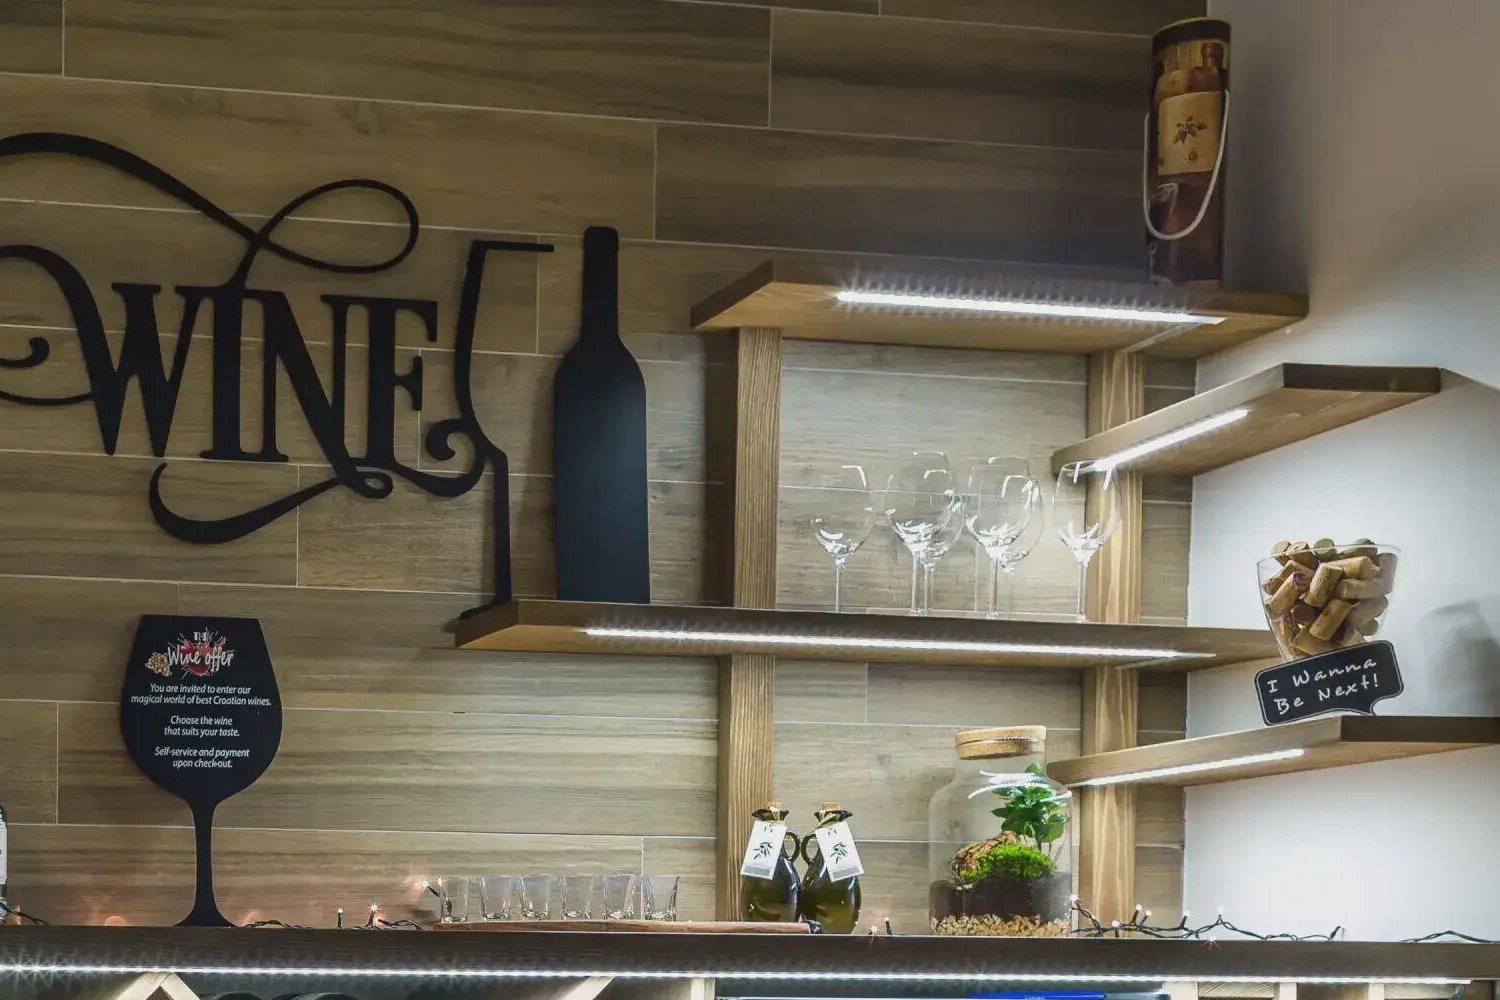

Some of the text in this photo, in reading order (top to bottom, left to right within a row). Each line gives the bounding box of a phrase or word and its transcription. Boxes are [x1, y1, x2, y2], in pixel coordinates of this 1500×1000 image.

[167, 645, 235, 672] Wine offer
[1267, 658, 1377, 693] I Wanna
[149, 683, 251, 695] You are invited to enter our
[1273, 673, 1379, 716] Be Next!
[131, 694, 272, 706] magical world of best Croatian wines.
[170, 715, 233, 726] Choose the wine
[164, 726, 240, 739] that suits your taste.
[154, 746, 250, 759] Self-service and payment
[172, 758, 233, 770] upon check-out.
